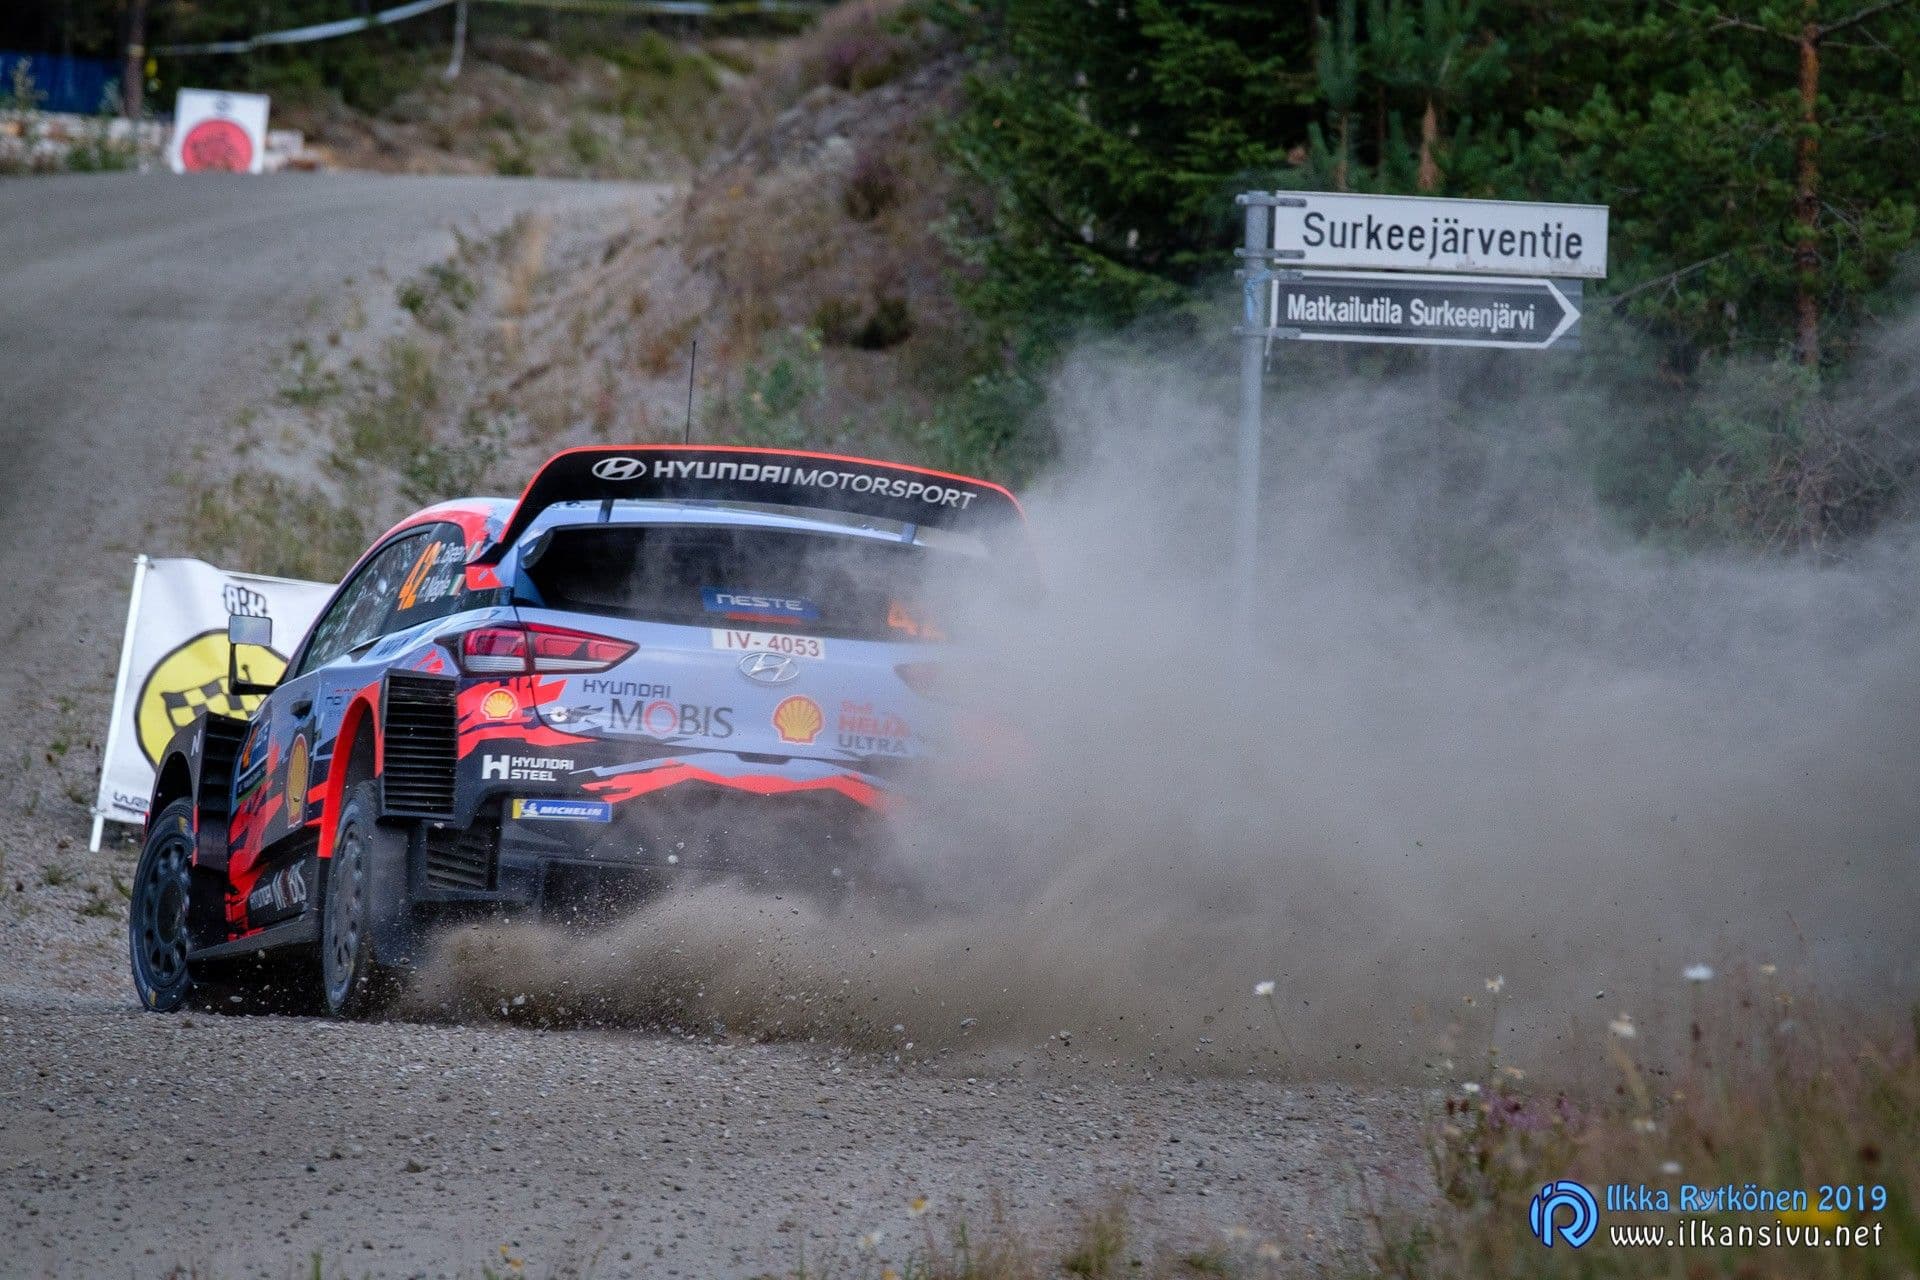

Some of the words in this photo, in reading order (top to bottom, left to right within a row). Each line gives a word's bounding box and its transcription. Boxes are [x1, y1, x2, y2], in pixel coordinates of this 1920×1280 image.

[1302, 210, 1583, 260] Surkeejärventie
[1287, 293, 1402, 325] Matkailutila
[1410, 297, 1535, 334] Surkeenjärvi
[653, 460, 790, 484] HYUNDAI
[794, 467, 978, 511] MOTORSPORT
[582, 679, 672, 699] HYUNDAI
[608, 698, 735, 739] MOBIS
[510, 769, 557, 782] STEEL
[511, 756, 575, 770] HYUNDAI
[539, 805, 603, 816] MICHELIN
